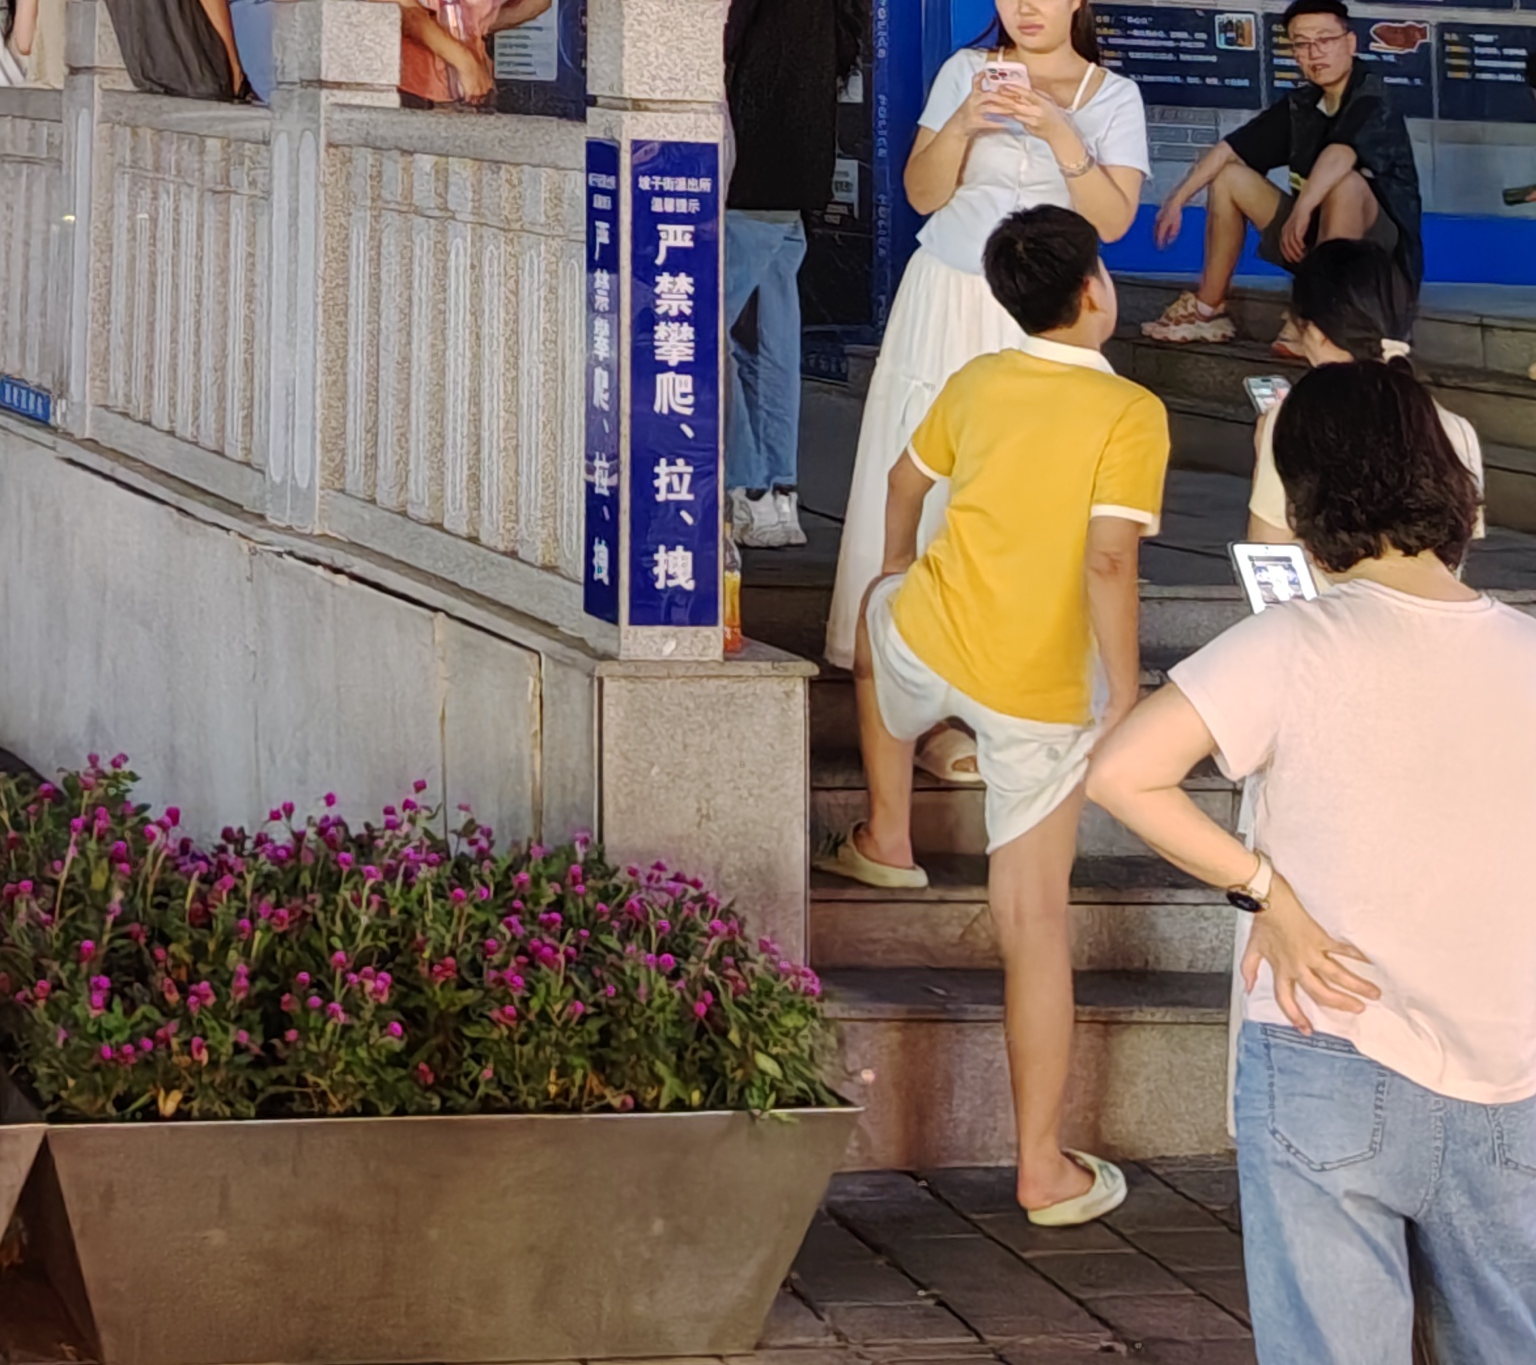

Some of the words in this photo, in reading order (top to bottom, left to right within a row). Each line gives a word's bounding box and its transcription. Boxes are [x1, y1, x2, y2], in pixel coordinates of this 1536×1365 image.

[652, 223, 696, 591] 严禁攀爬、拉、拽
